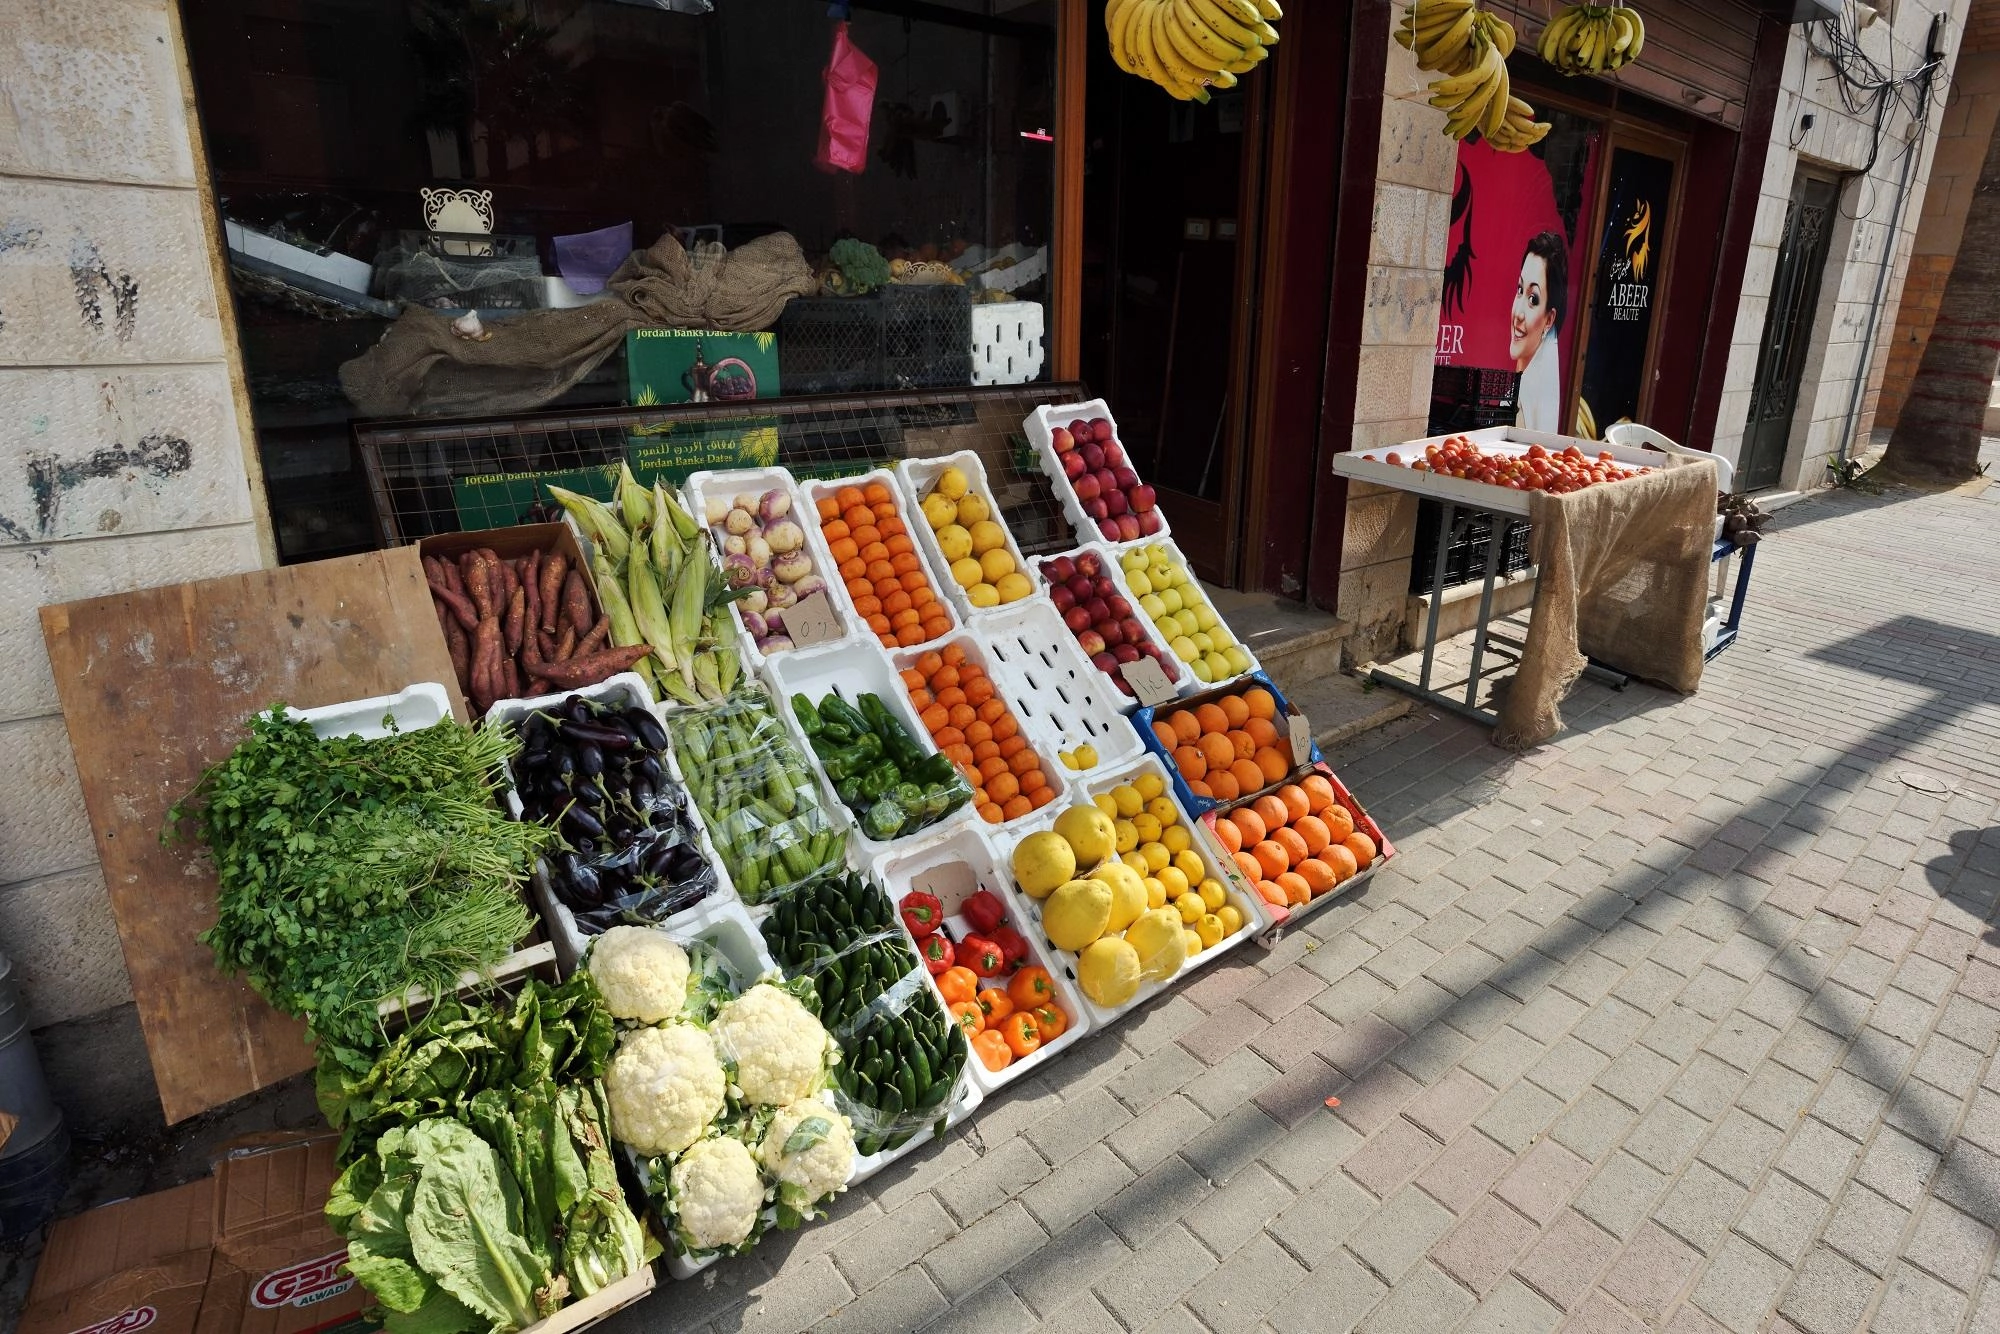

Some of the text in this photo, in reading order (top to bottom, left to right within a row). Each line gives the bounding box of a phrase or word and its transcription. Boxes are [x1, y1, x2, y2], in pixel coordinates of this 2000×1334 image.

[1607, 283, 1649, 308] ABEER
[1613, 308, 1639, 321] BEAUTE
[637, 328, 671, 339] Jordan
[674, 328, 704, 337] Banks
[639, 453, 734, 471] Jordan Banks Dates
[464, 474, 504, 487] Jordan
[299, 1283, 348, 1306] ALWADI
